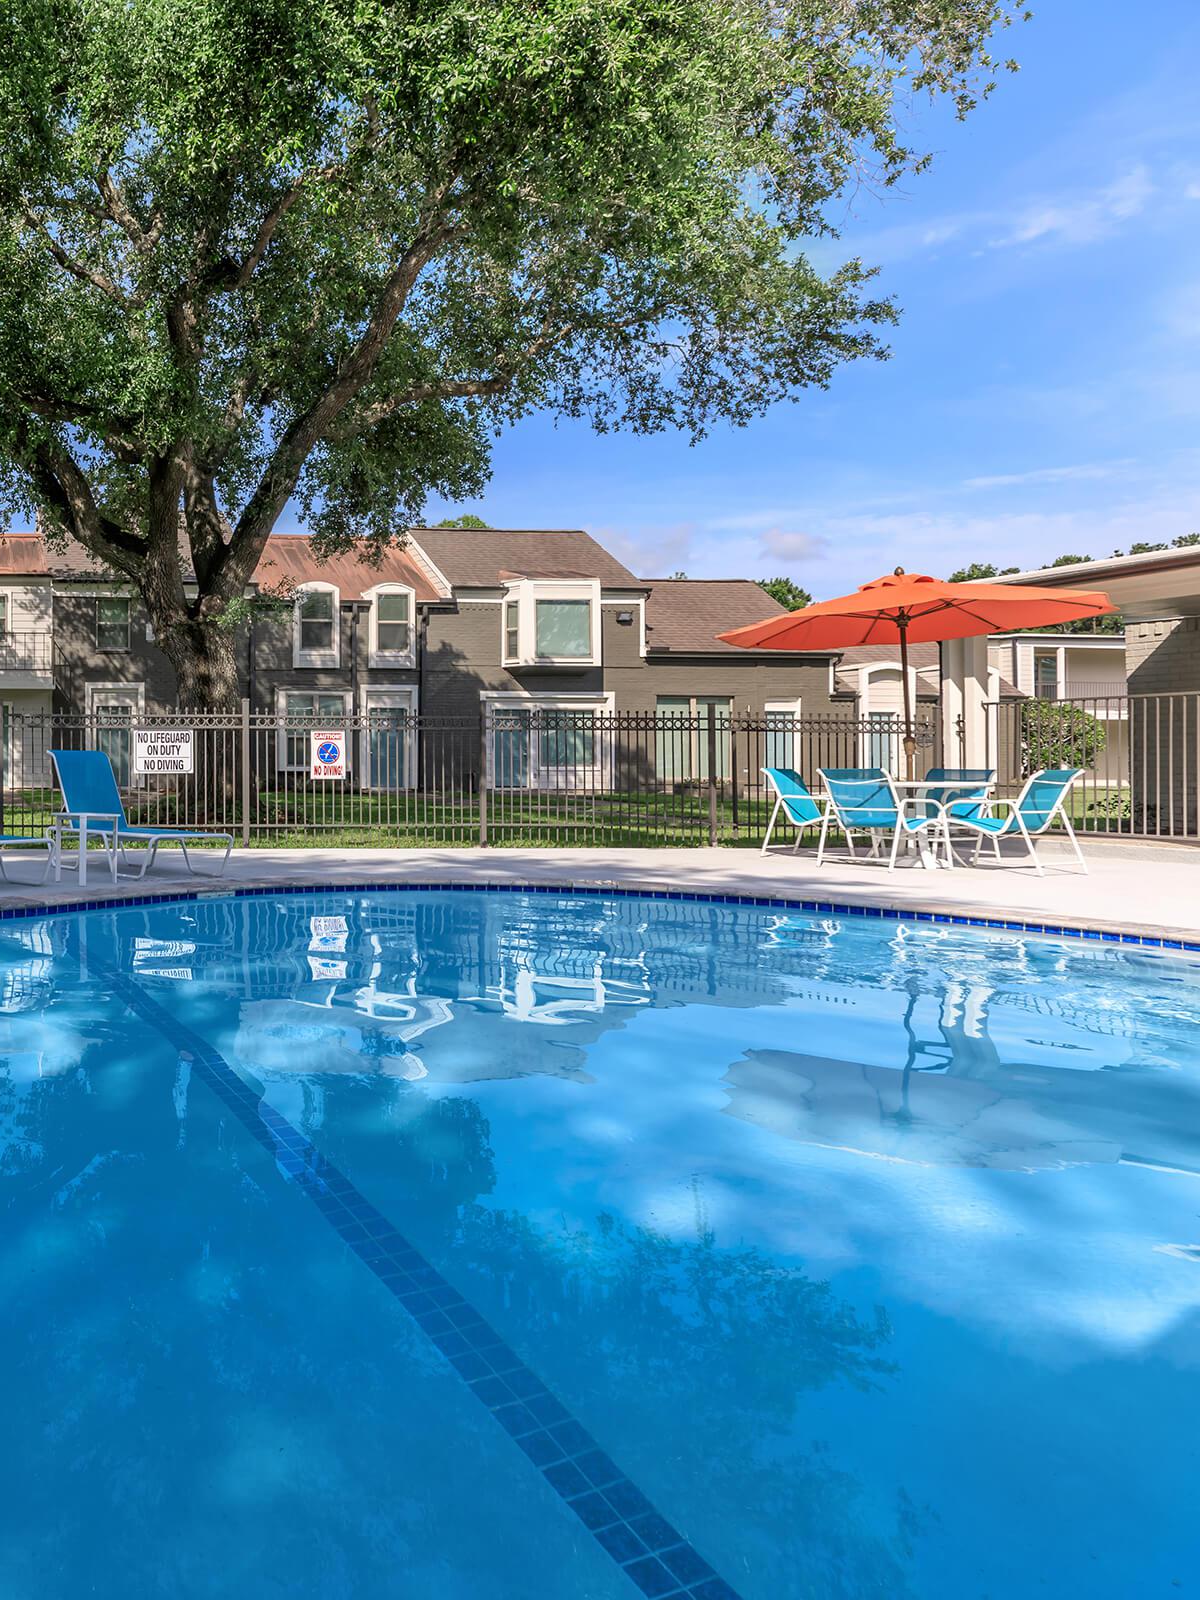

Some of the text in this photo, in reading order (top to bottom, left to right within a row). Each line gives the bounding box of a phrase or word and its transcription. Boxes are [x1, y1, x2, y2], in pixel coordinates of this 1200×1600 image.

[137, 733, 190, 744] NO LIFEGUARD
[147, 745, 181, 755] ON DUTY
[144, 759, 184, 770] NO DIVING
[314, 765, 322, 776] NO
